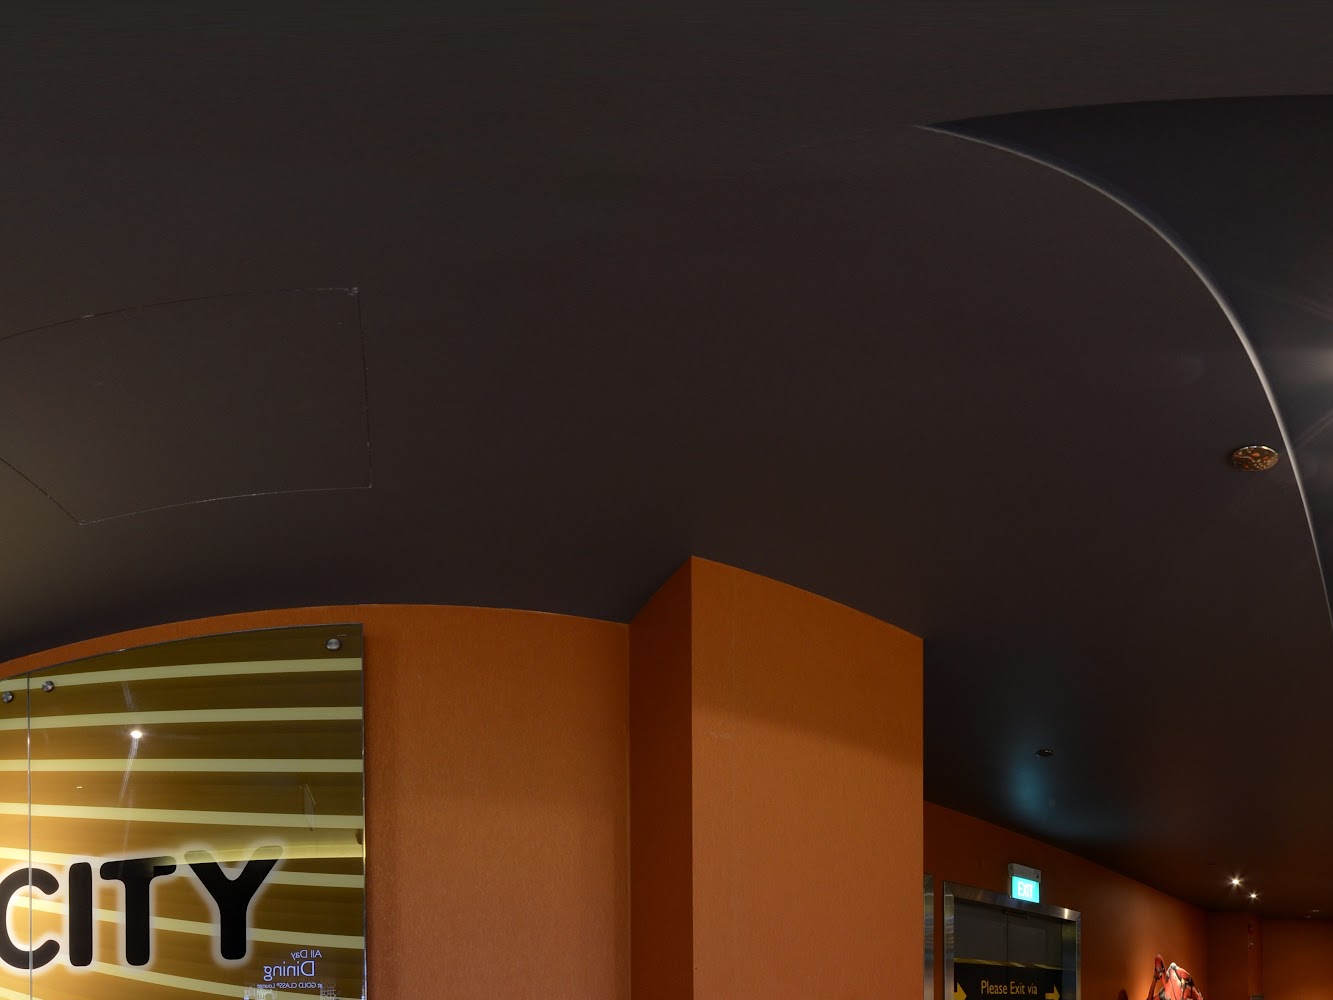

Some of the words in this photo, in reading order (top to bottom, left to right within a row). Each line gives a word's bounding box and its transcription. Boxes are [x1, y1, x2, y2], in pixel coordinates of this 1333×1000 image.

[1017, 882, 1034, 899] EXIT
[0, 845, 283, 970] CITY
[980, 980, 1008, 996] Please
[1009, 981, 1026, 995] Exit
[1027, 983, 1038, 995] via
